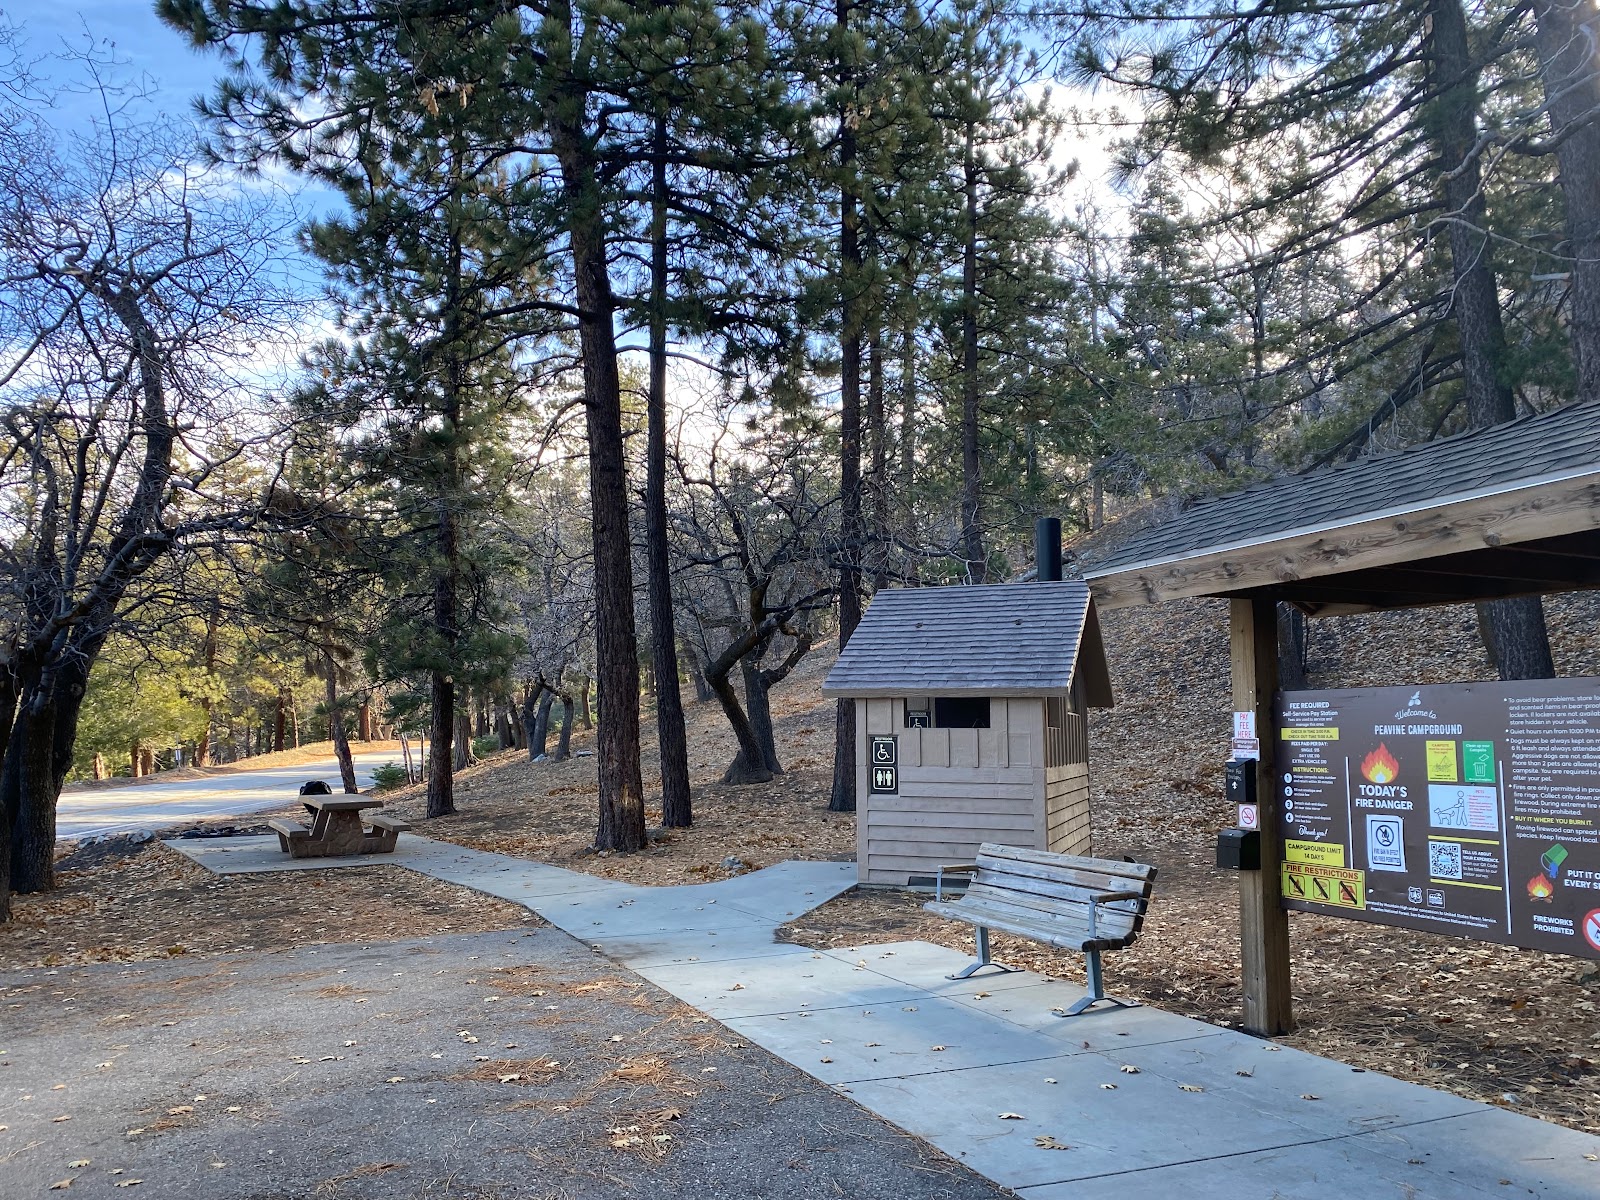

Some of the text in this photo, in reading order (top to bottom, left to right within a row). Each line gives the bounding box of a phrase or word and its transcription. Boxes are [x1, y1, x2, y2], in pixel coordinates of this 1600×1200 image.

[1395, 708, 1437, 720] Welcome to
[1375, 724, 1462, 735] PEAVINE CAMPGROUND
[1359, 785, 1407, 797] TODAY'S
[1356, 798, 1413, 810] FIRE DANGER
[1299, 825, 1316, 835] Thank
[1288, 844, 1325, 852] CAMPGROUND
[1305, 867, 1358, 879] RESTRICTIONS
[1568, 870, 1584, 878] PUT
[1564, 879, 1591, 888] EVERY
[1533, 915, 1573, 926] FIREWORKS
[1534, 924, 1574, 935] PROHIBITED
